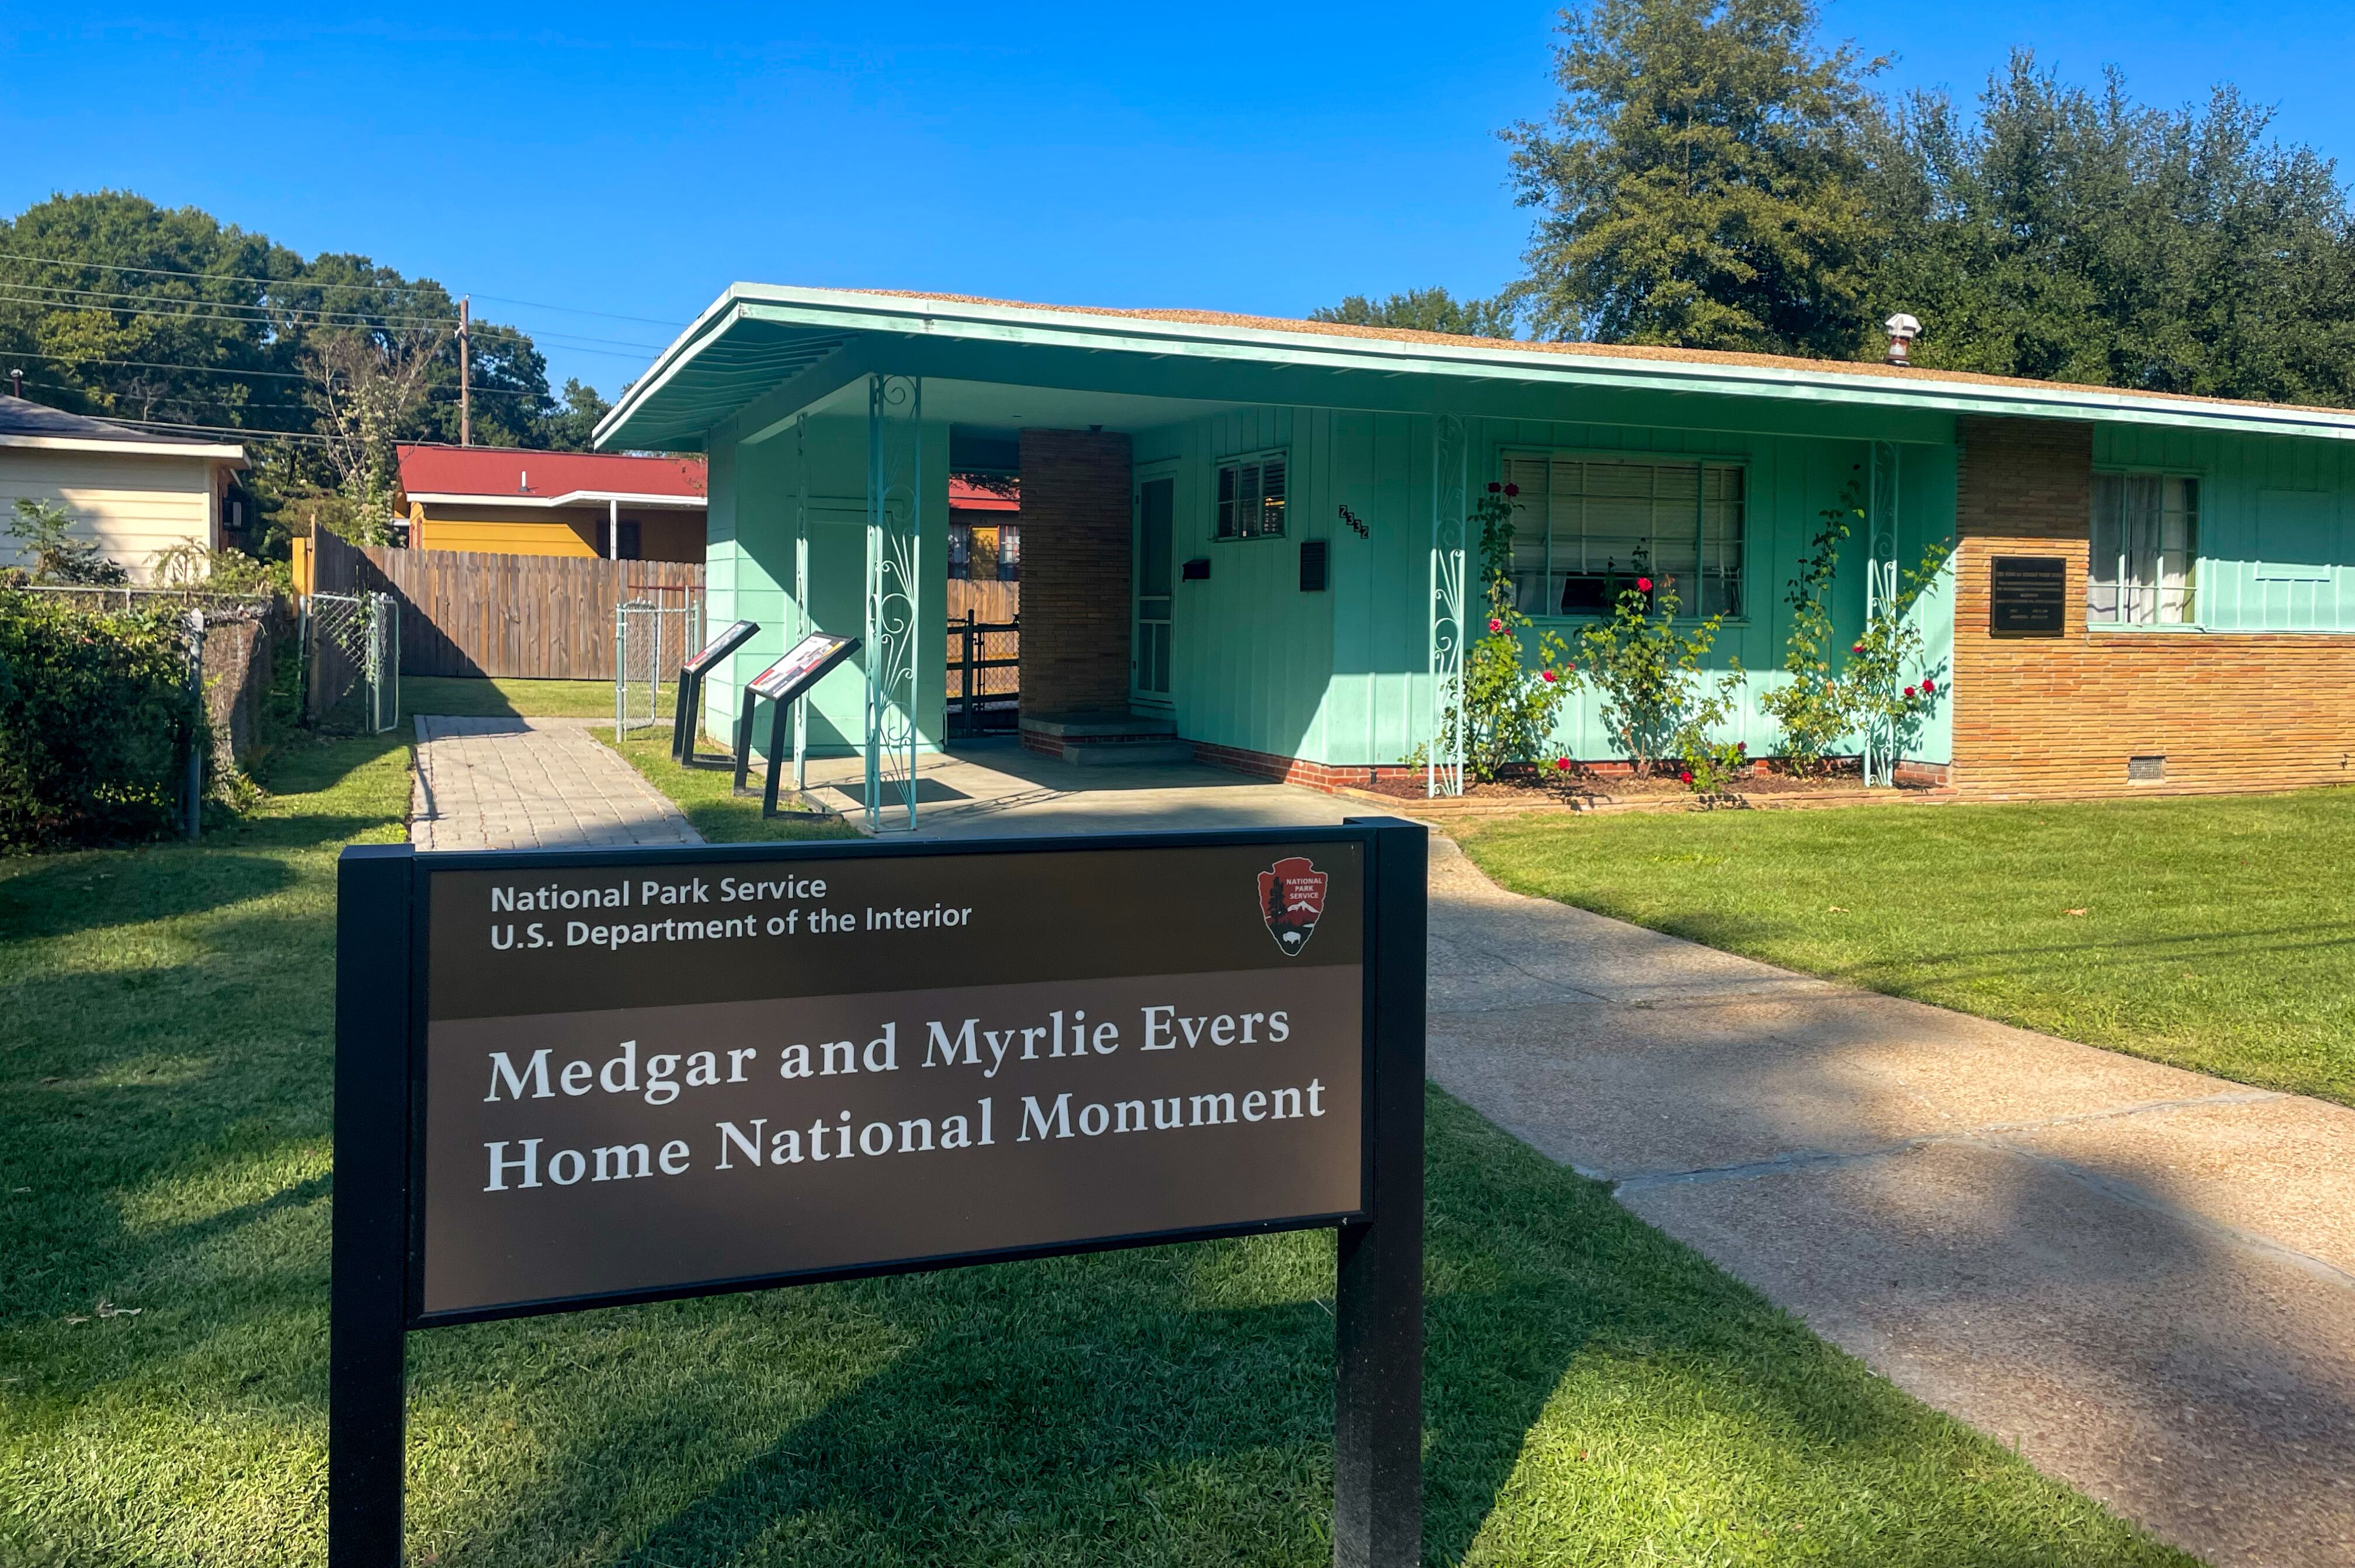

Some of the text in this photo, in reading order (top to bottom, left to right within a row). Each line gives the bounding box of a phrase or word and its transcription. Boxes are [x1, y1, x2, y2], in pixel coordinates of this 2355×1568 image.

[1340, 506, 1368, 538] 2332
[492, 874, 826, 912] National Park Service
[491, 903, 972, 951] U.S. Department of the Interior
[484, 1005, 1289, 1105] Medgar and Myrlie Evers
[484, 1078, 1326, 1192] Home National Monument
